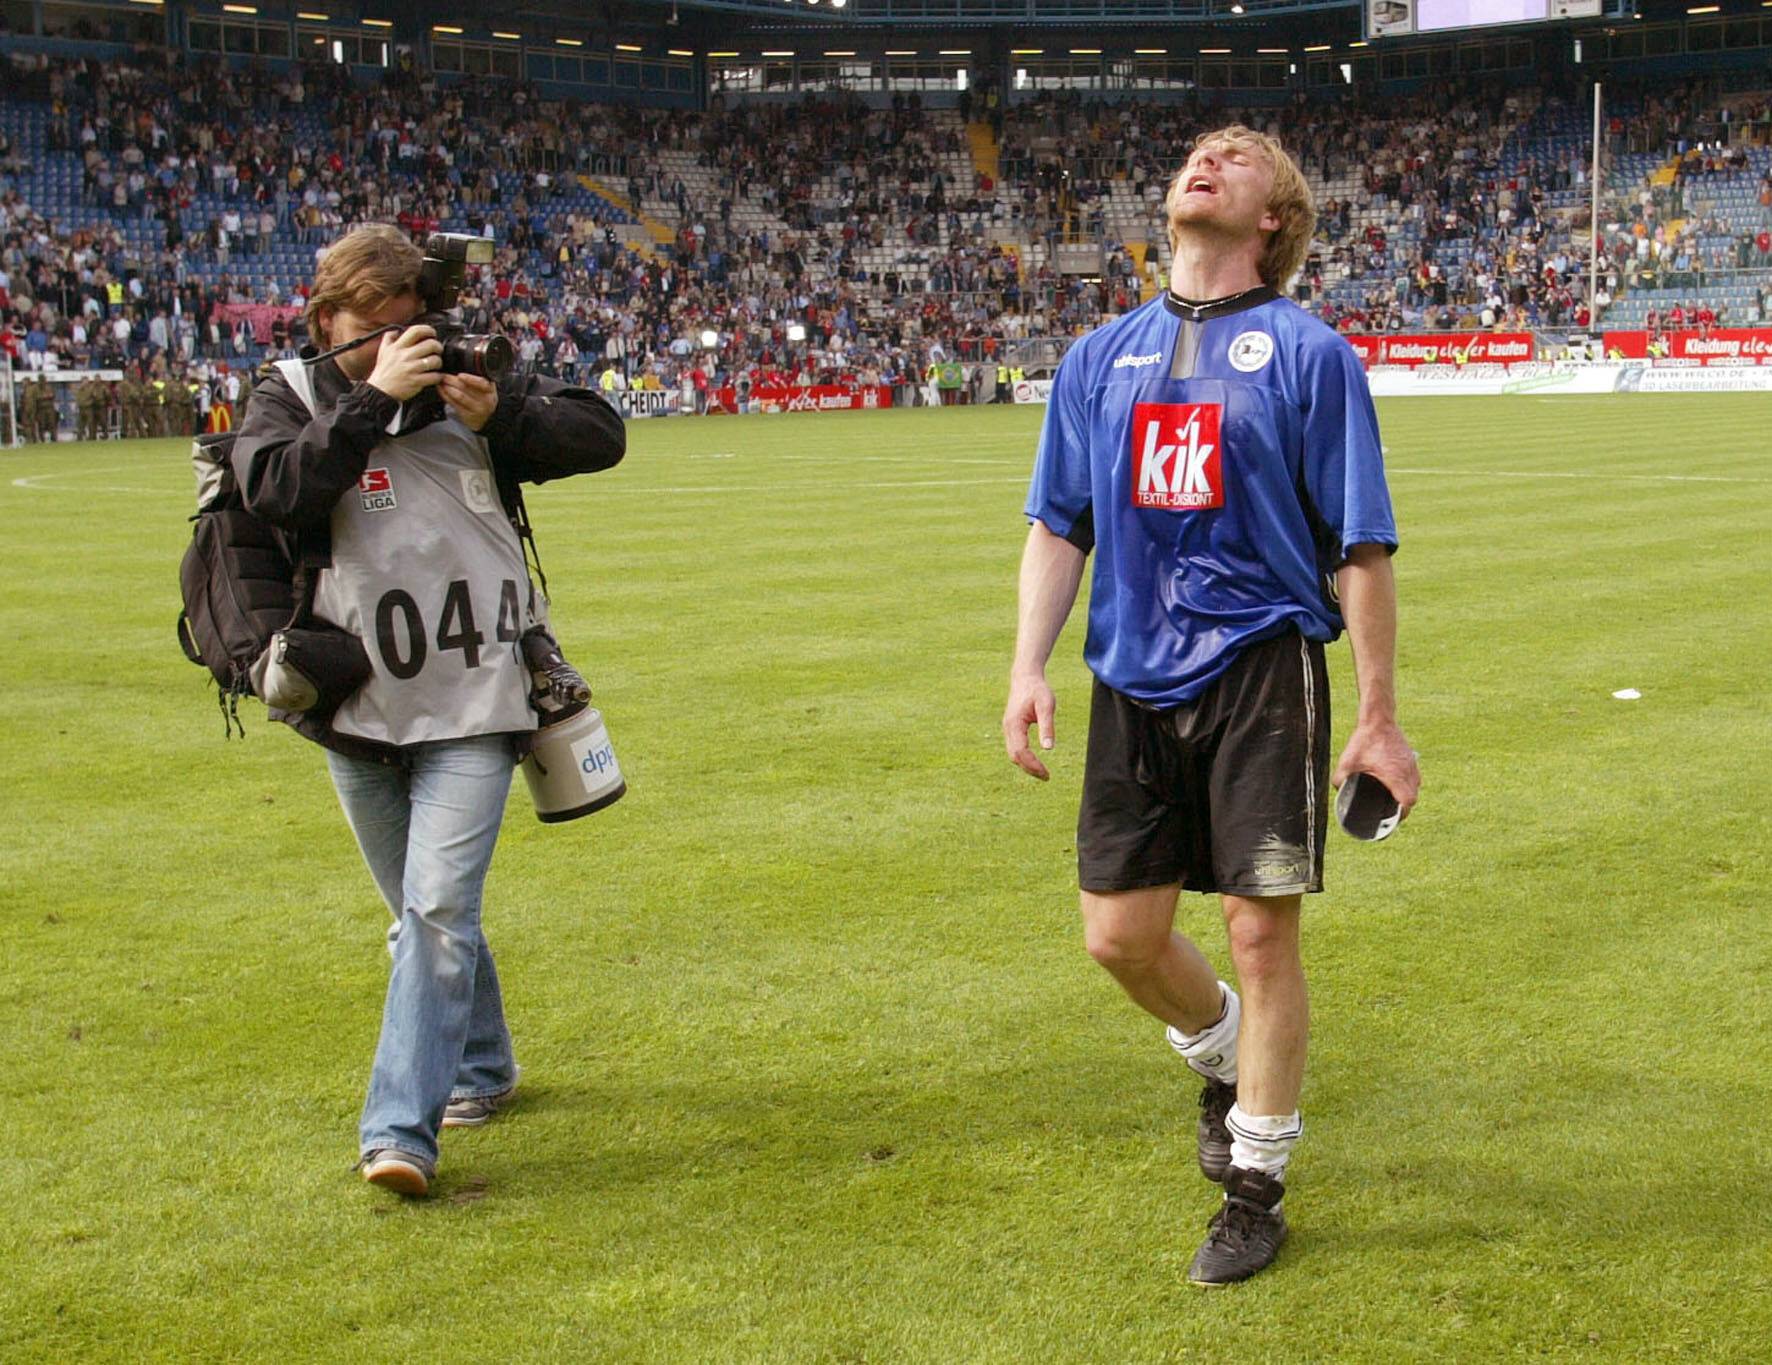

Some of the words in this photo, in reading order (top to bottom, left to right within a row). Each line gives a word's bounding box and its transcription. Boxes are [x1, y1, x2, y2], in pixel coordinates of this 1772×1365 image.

[1388, 342, 1438, 360] Kleidung
[1439, 336, 1486, 357] clever
[1488, 341, 1529, 357] kaufen
[1684, 337, 1740, 356] Kleidung
[1113, 351, 1162, 369] uhlsport
[1137, 407, 1214, 493] kik
[362, 497, 396, 511] LIGA
[1137, 491, 1214, 506] TEXTIL-DISKONT
